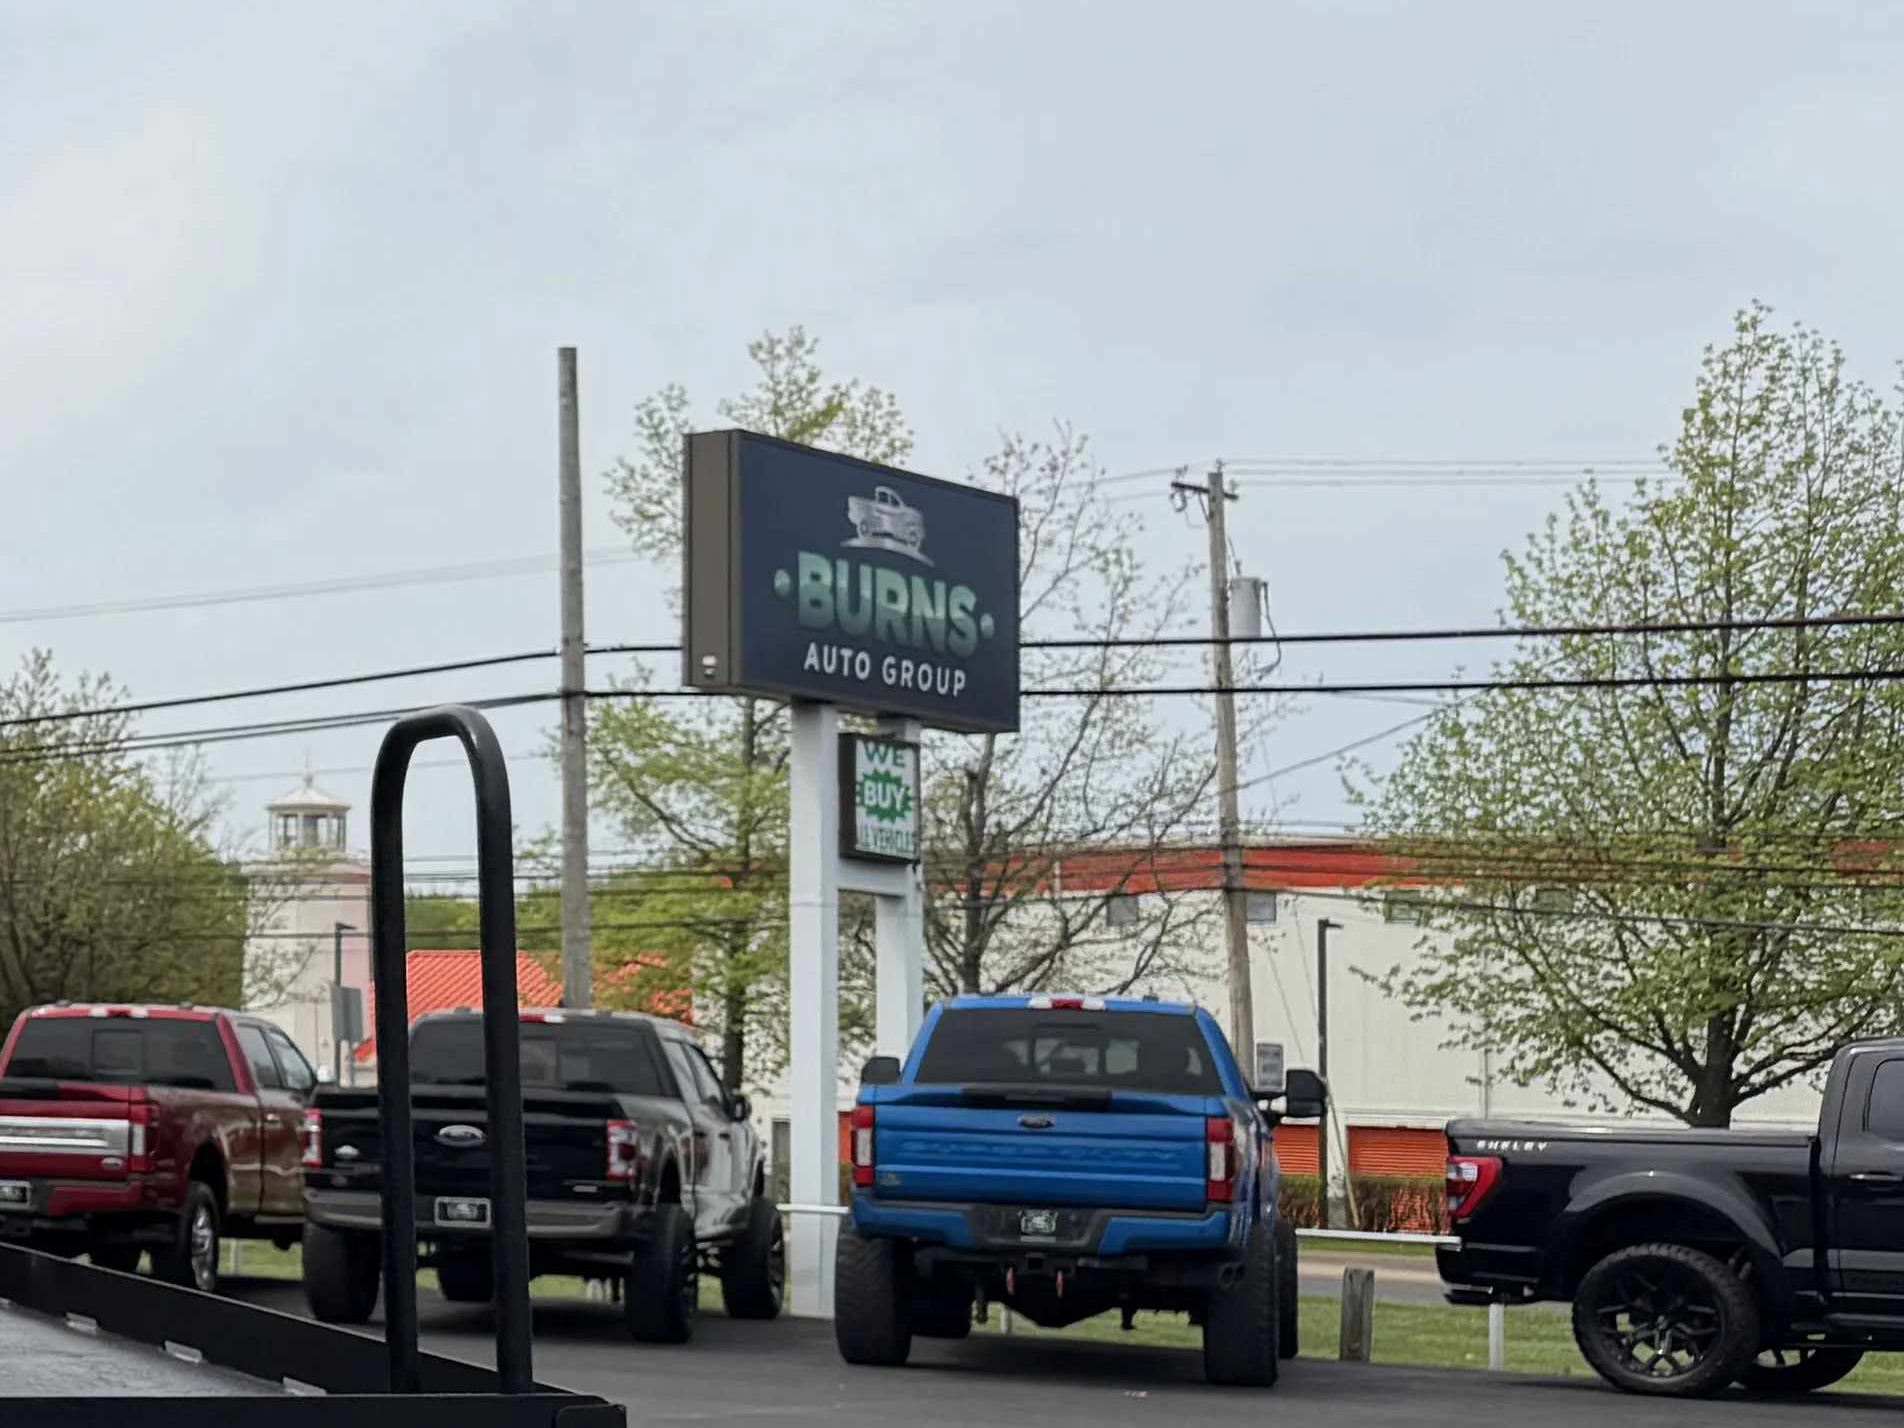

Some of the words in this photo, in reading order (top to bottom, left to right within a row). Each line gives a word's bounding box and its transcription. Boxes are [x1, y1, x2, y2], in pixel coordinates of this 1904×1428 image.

[798, 550, 978, 659] BURNS
[803, 641, 871, 681] AUTO
[881, 655, 966, 697] GROUP
[863, 740, 906, 768] WE
[863, 778, 904, 812] BUY
